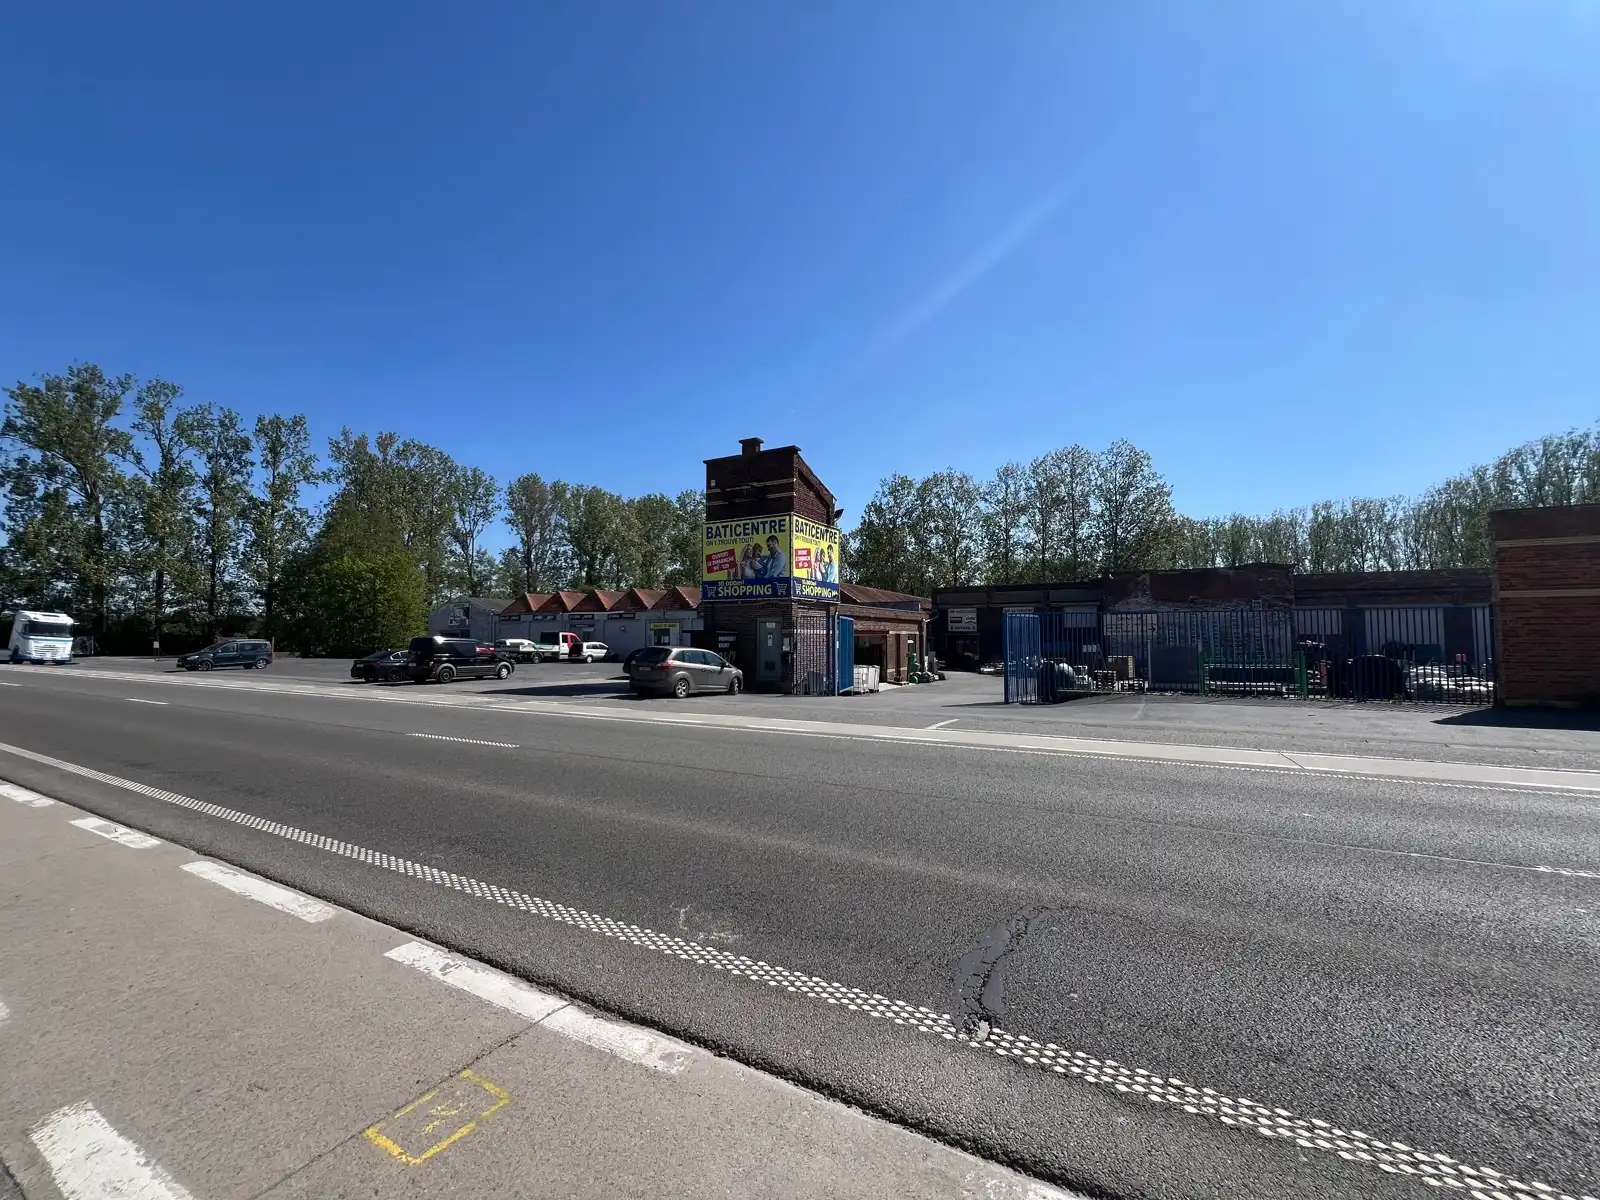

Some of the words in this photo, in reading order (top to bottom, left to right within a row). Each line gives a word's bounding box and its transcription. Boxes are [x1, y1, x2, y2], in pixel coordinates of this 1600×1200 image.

[706, 519, 786, 539] BATICENTRE
[795, 519, 837, 544] BATICENTRE
[718, 584, 772, 597] SHOPPING
[802, 584, 831, 598] SHOPPING
